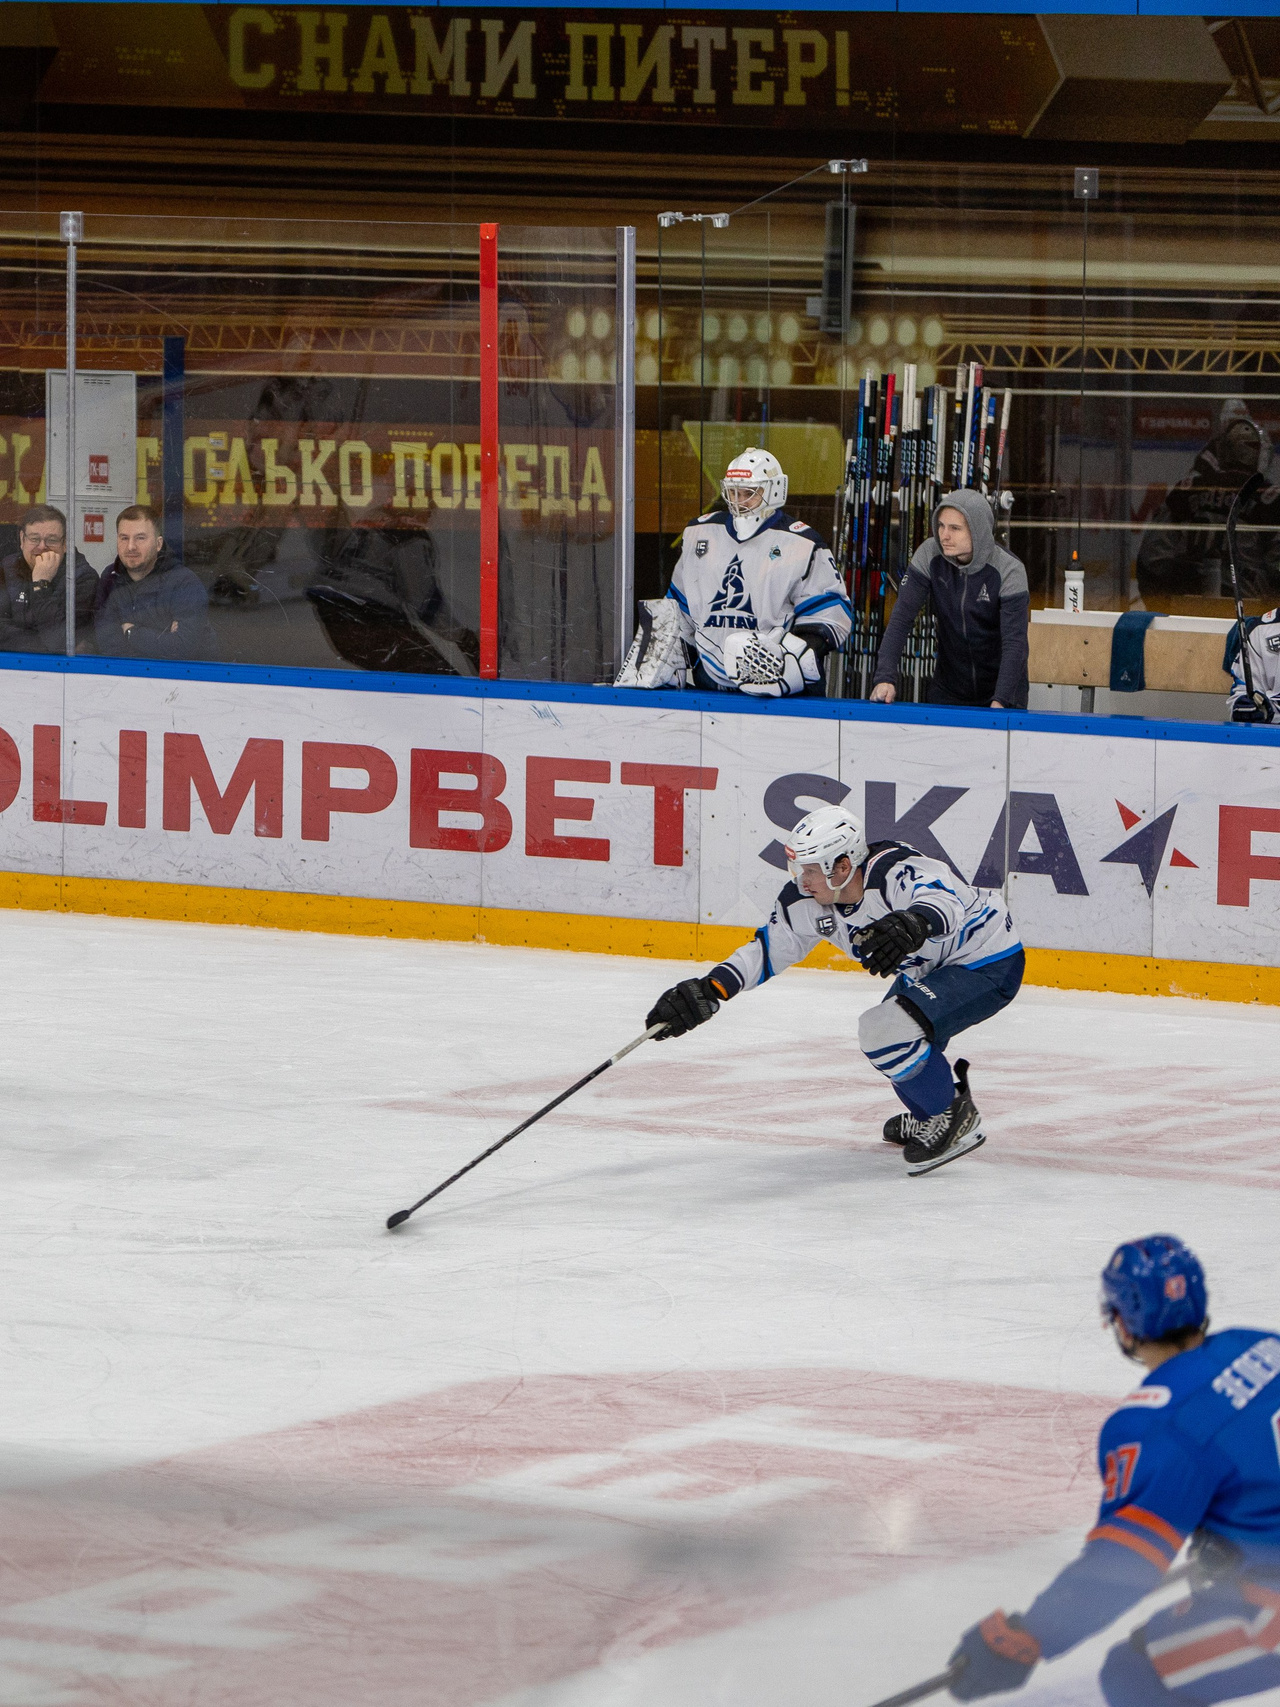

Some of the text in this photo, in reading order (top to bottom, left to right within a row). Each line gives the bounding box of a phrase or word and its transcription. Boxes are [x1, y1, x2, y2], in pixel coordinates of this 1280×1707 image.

[296, 11, 537, 99] НАМИ
[564, 21, 851, 106] ПИТЕР!
[758, 771, 1091, 897] SKA
